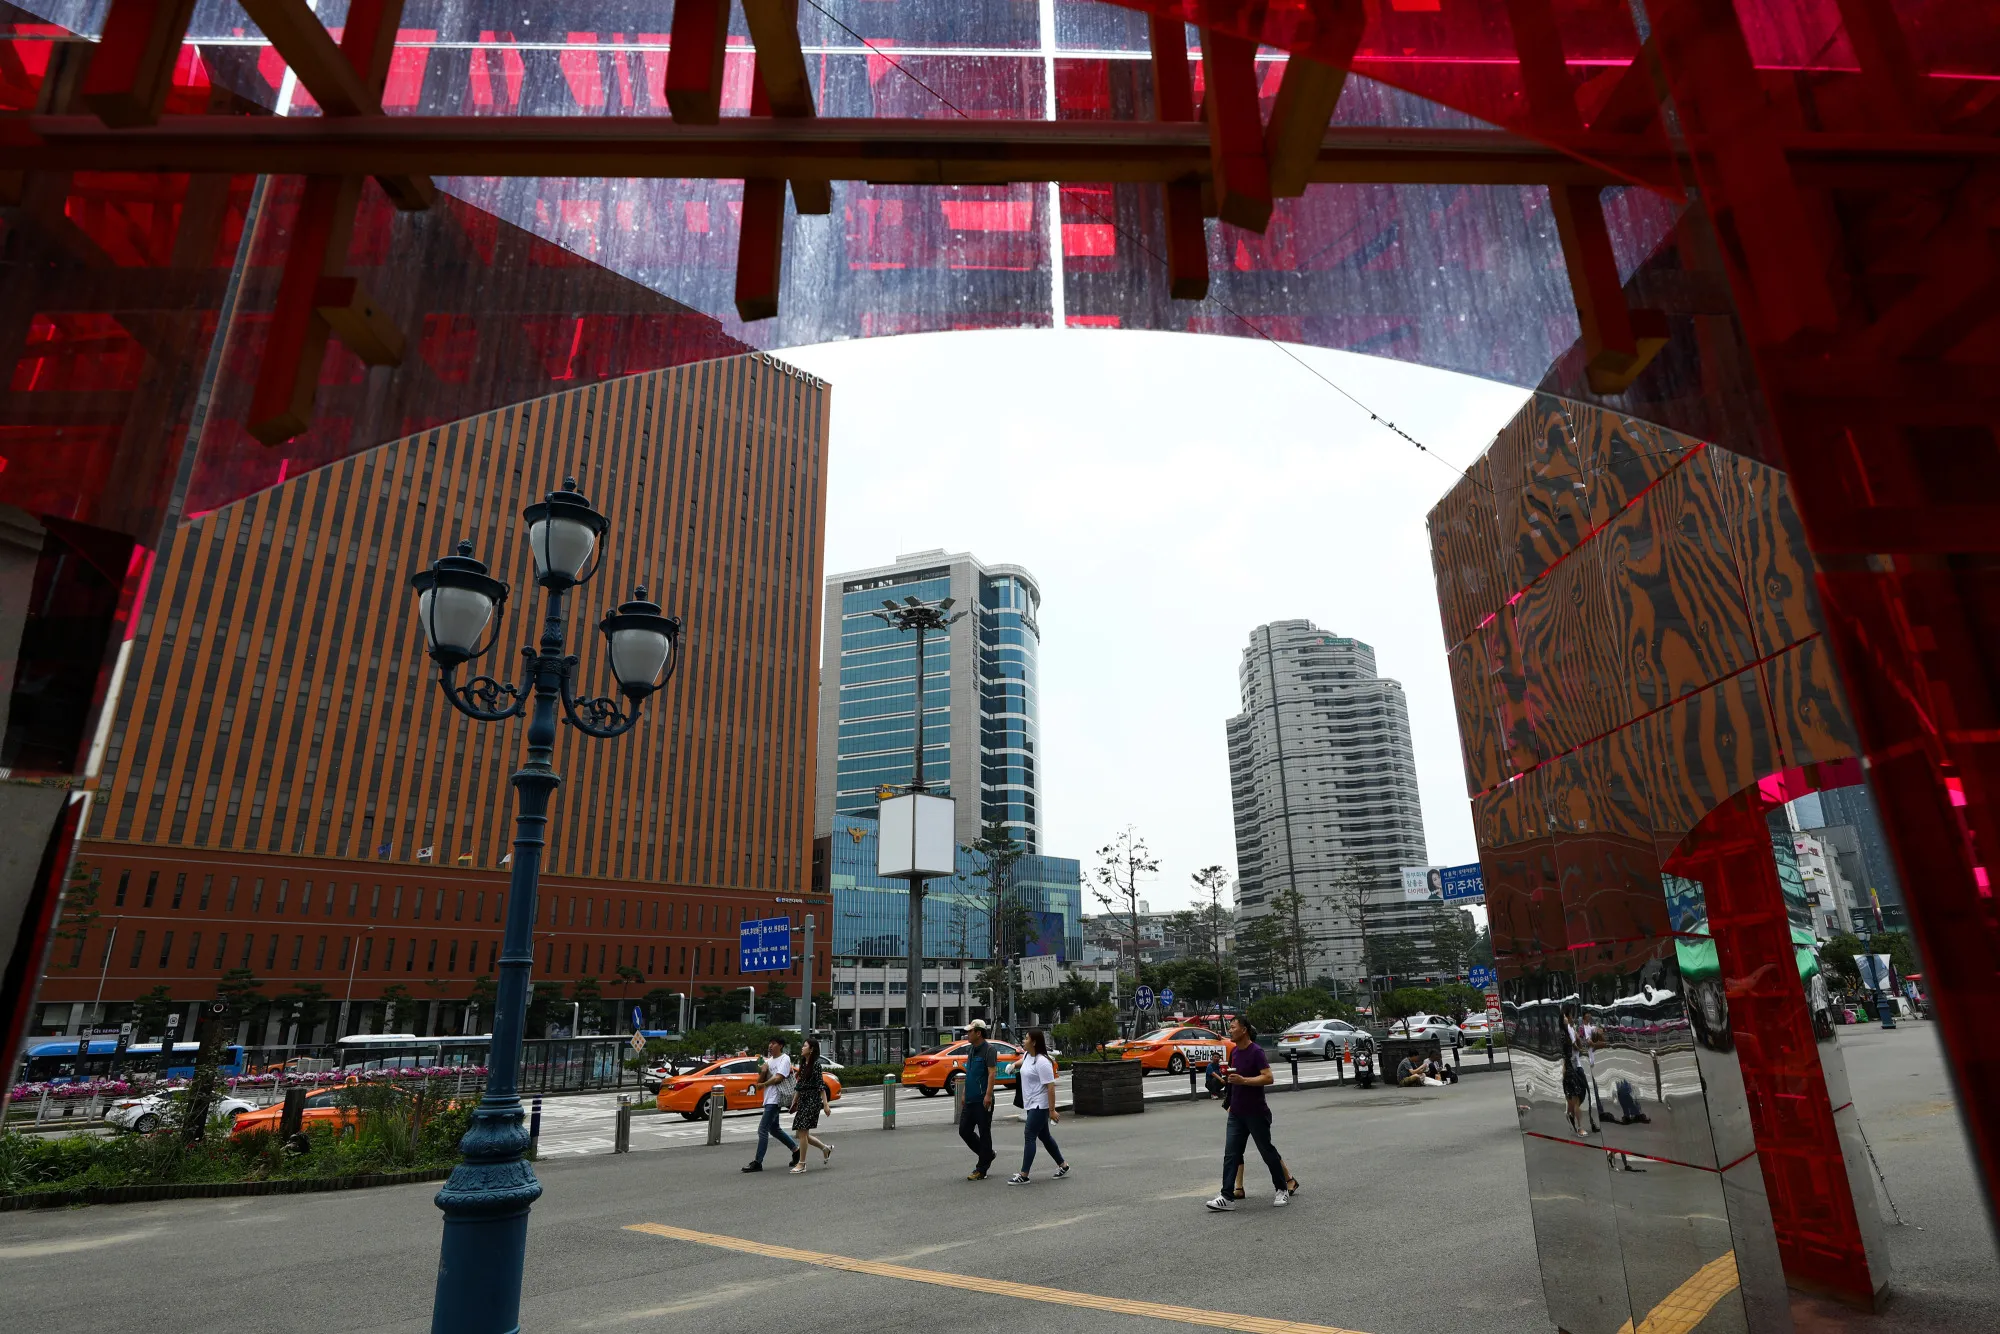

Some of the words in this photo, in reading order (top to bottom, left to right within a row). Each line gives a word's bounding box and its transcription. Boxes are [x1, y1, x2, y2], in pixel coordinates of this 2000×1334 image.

[763, 352, 823, 390] SQUARE
[1447, 883, 1454, 894] P
[1138, 989, 1150, 997] 택시
[1139, 997, 1151, 1005] 하차
[168, 1029, 174, 1037] 4
[120, 1037, 127, 1045] 5
